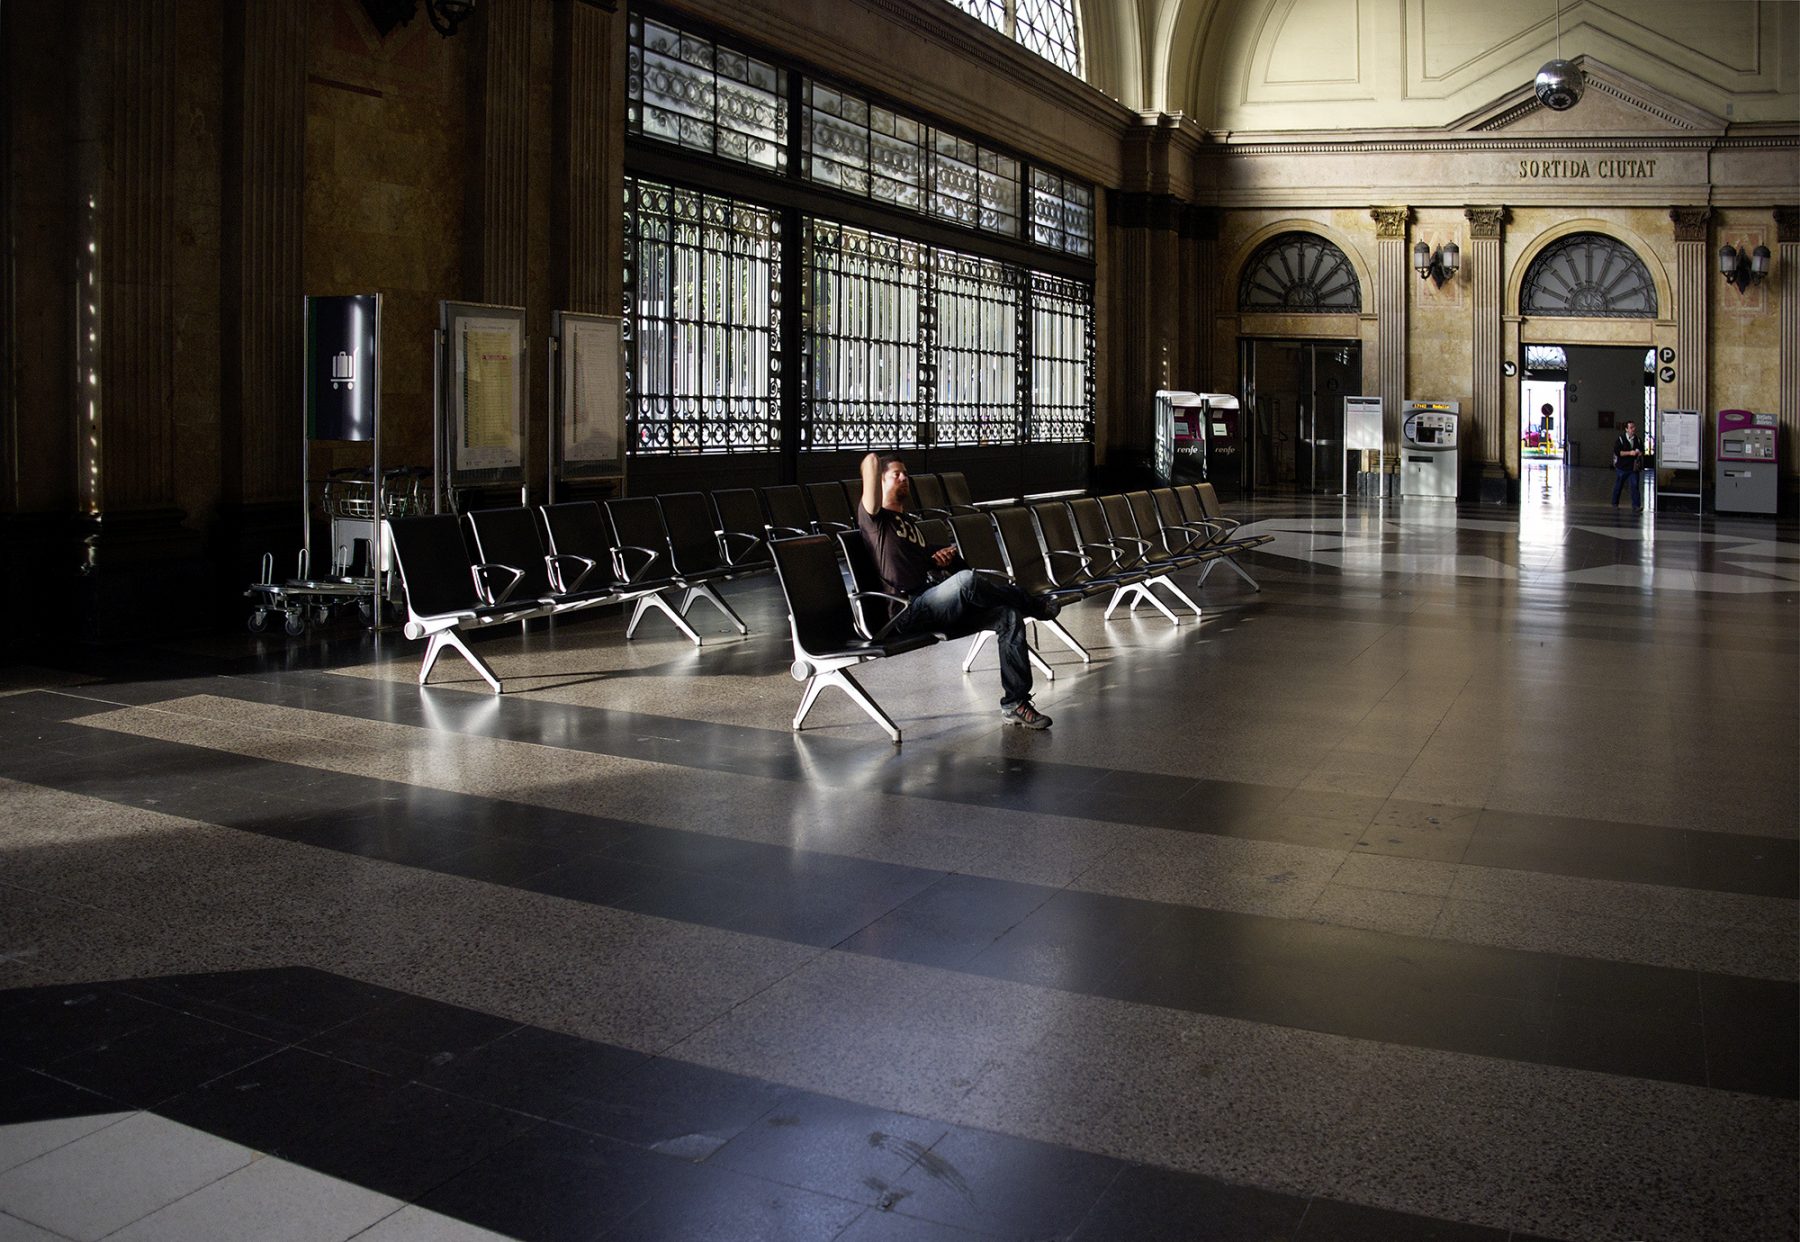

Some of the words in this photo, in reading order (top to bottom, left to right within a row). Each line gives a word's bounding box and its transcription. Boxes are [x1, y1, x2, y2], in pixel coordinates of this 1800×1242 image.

[1519, 160, 1590, 178] SORTIDA
[1598, 160, 1656, 178] CIUTAT
[1663, 349, 1673, 361] P
[1177, 445, 1198, 456] renfe
[1215, 446, 1236, 456] renfe
[895, 515, 926, 547] 330
